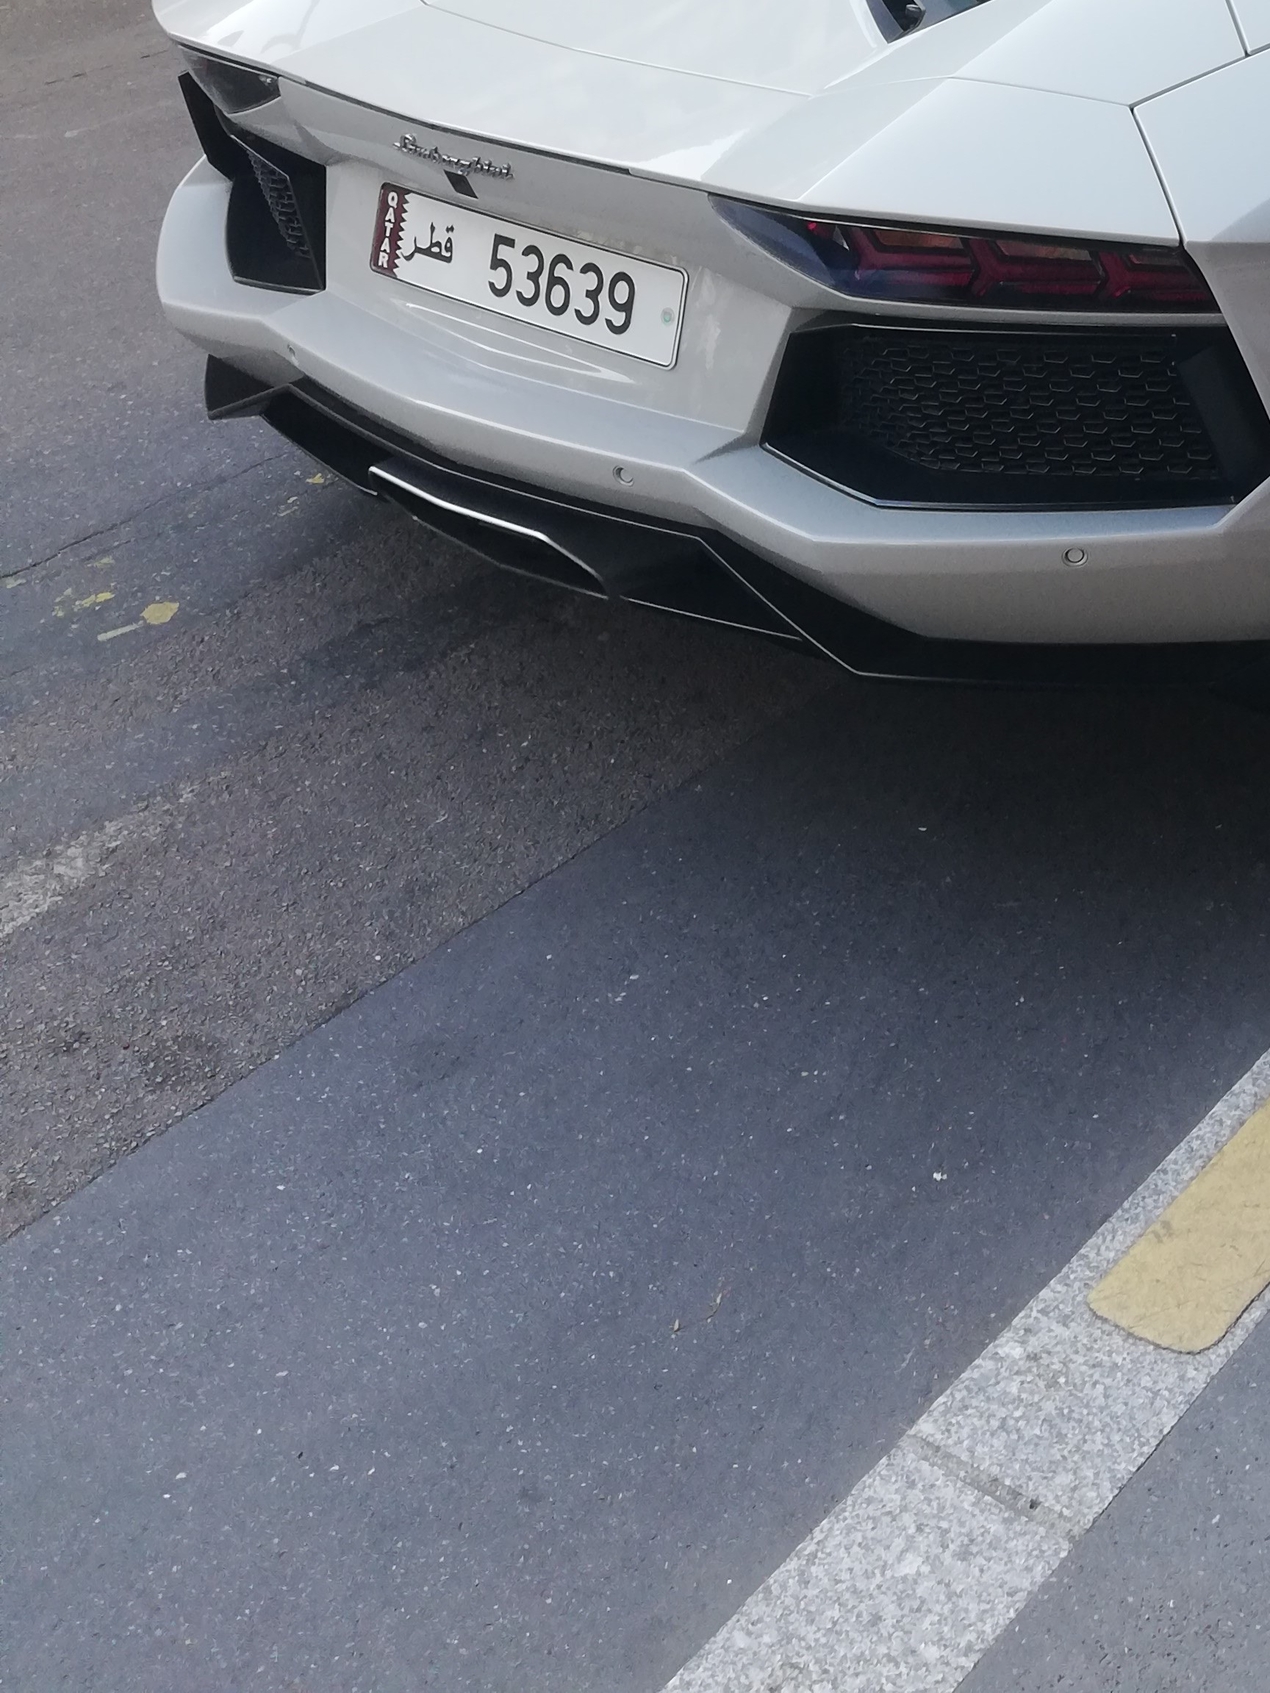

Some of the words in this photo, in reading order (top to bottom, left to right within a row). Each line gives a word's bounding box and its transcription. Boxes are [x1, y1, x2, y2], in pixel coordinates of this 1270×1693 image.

[393, 133, 515, 181] Lamborghini
[377, 191, 399, 270] QATAR
[401, 222, 455, 264] قطر
[487, 232, 636, 336] 53639
